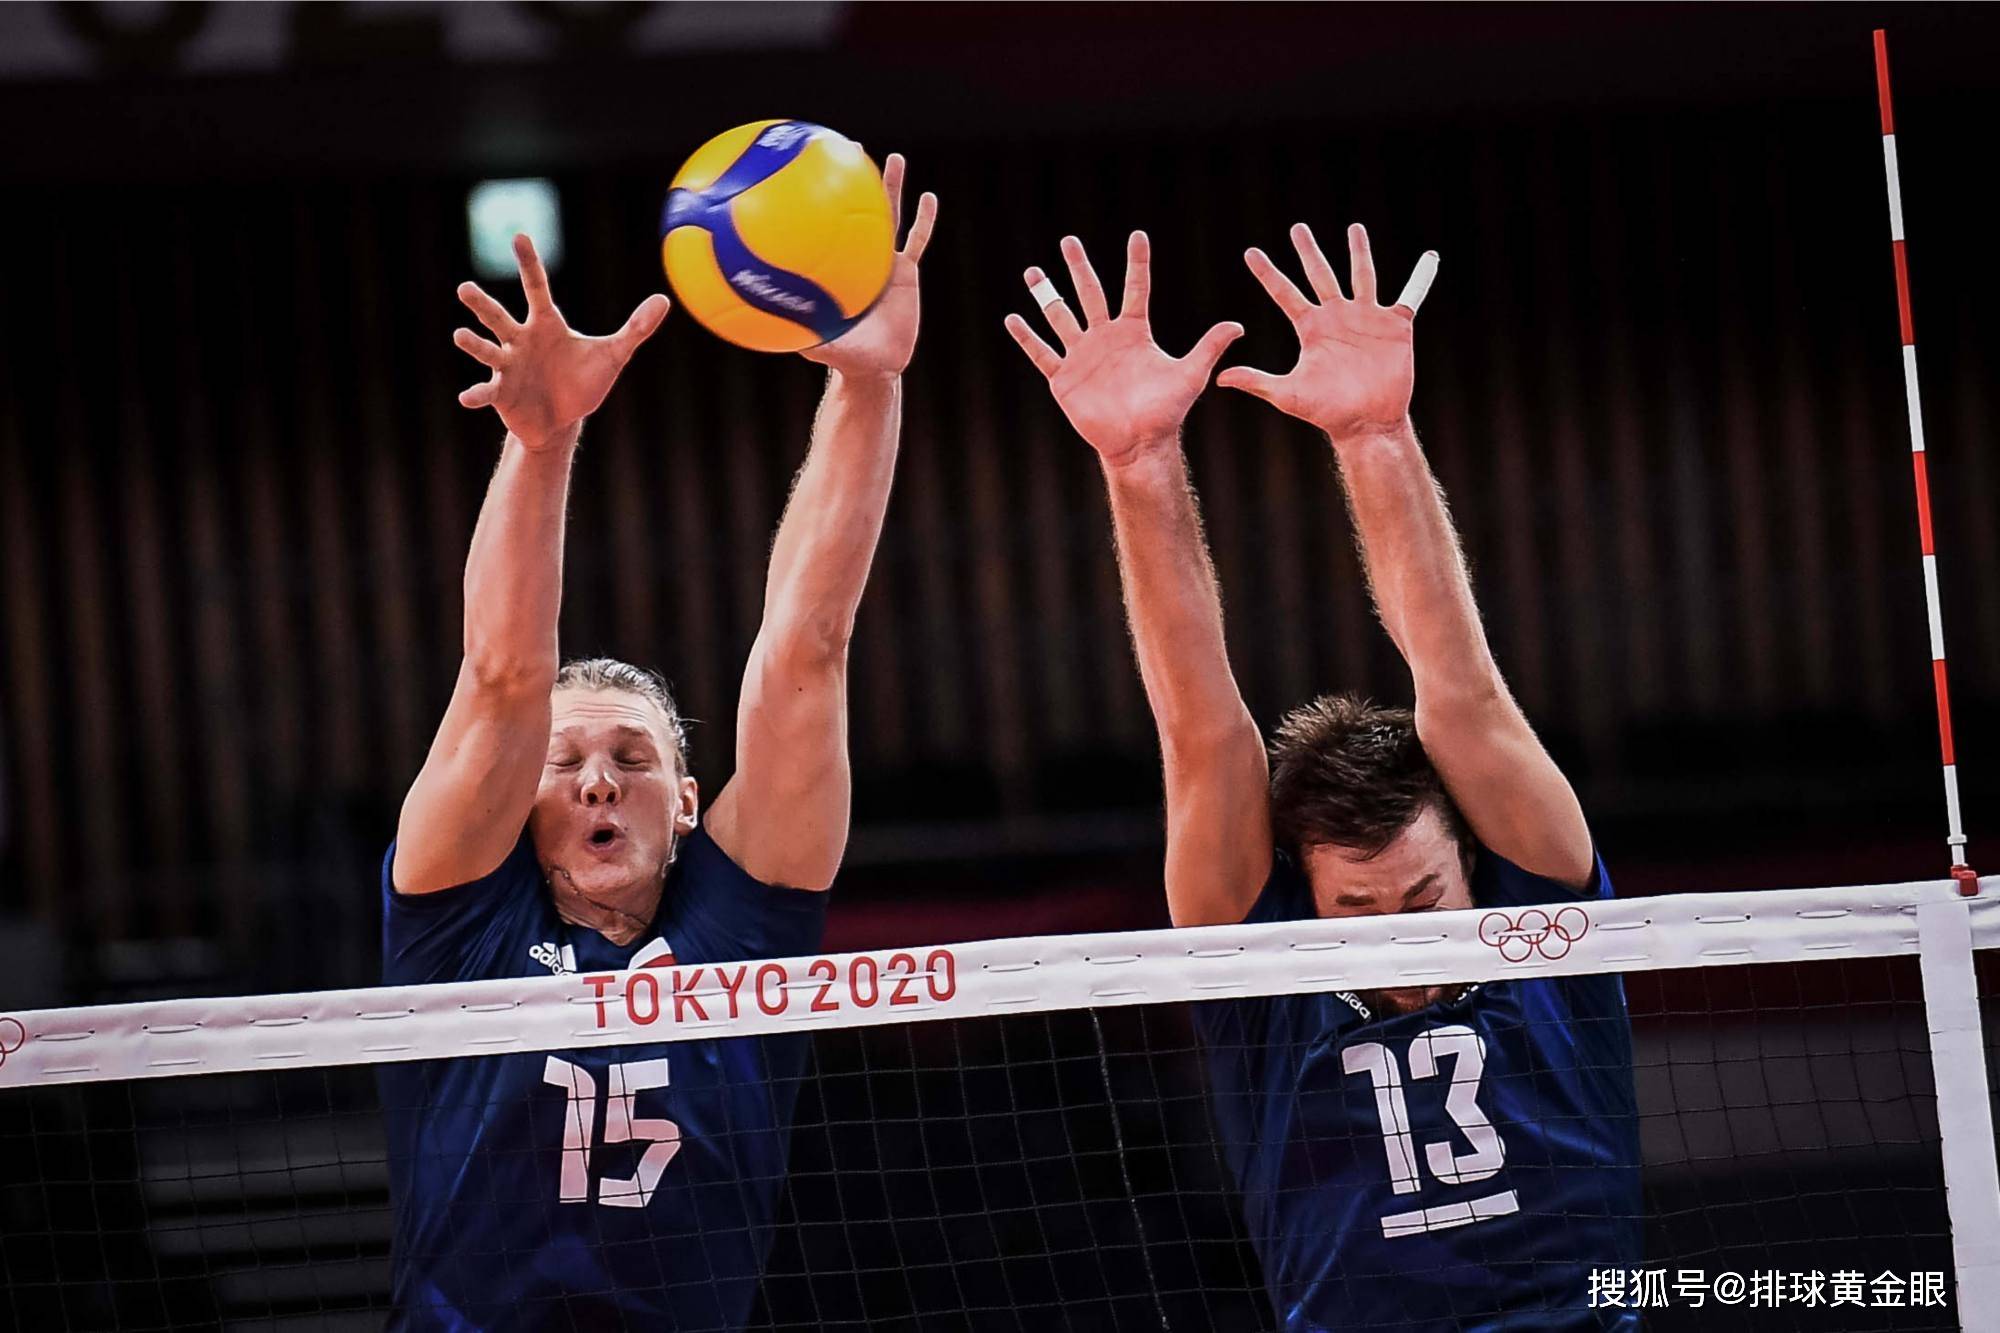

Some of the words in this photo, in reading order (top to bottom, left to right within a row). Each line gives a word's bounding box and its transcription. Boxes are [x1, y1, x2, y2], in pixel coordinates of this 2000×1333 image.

[582, 963, 789, 1029] TOKYO
[807, 949, 956, 1013] 2020
[543, 1055, 682, 1208] 15
[1341, 1024, 1506, 1195] 13
